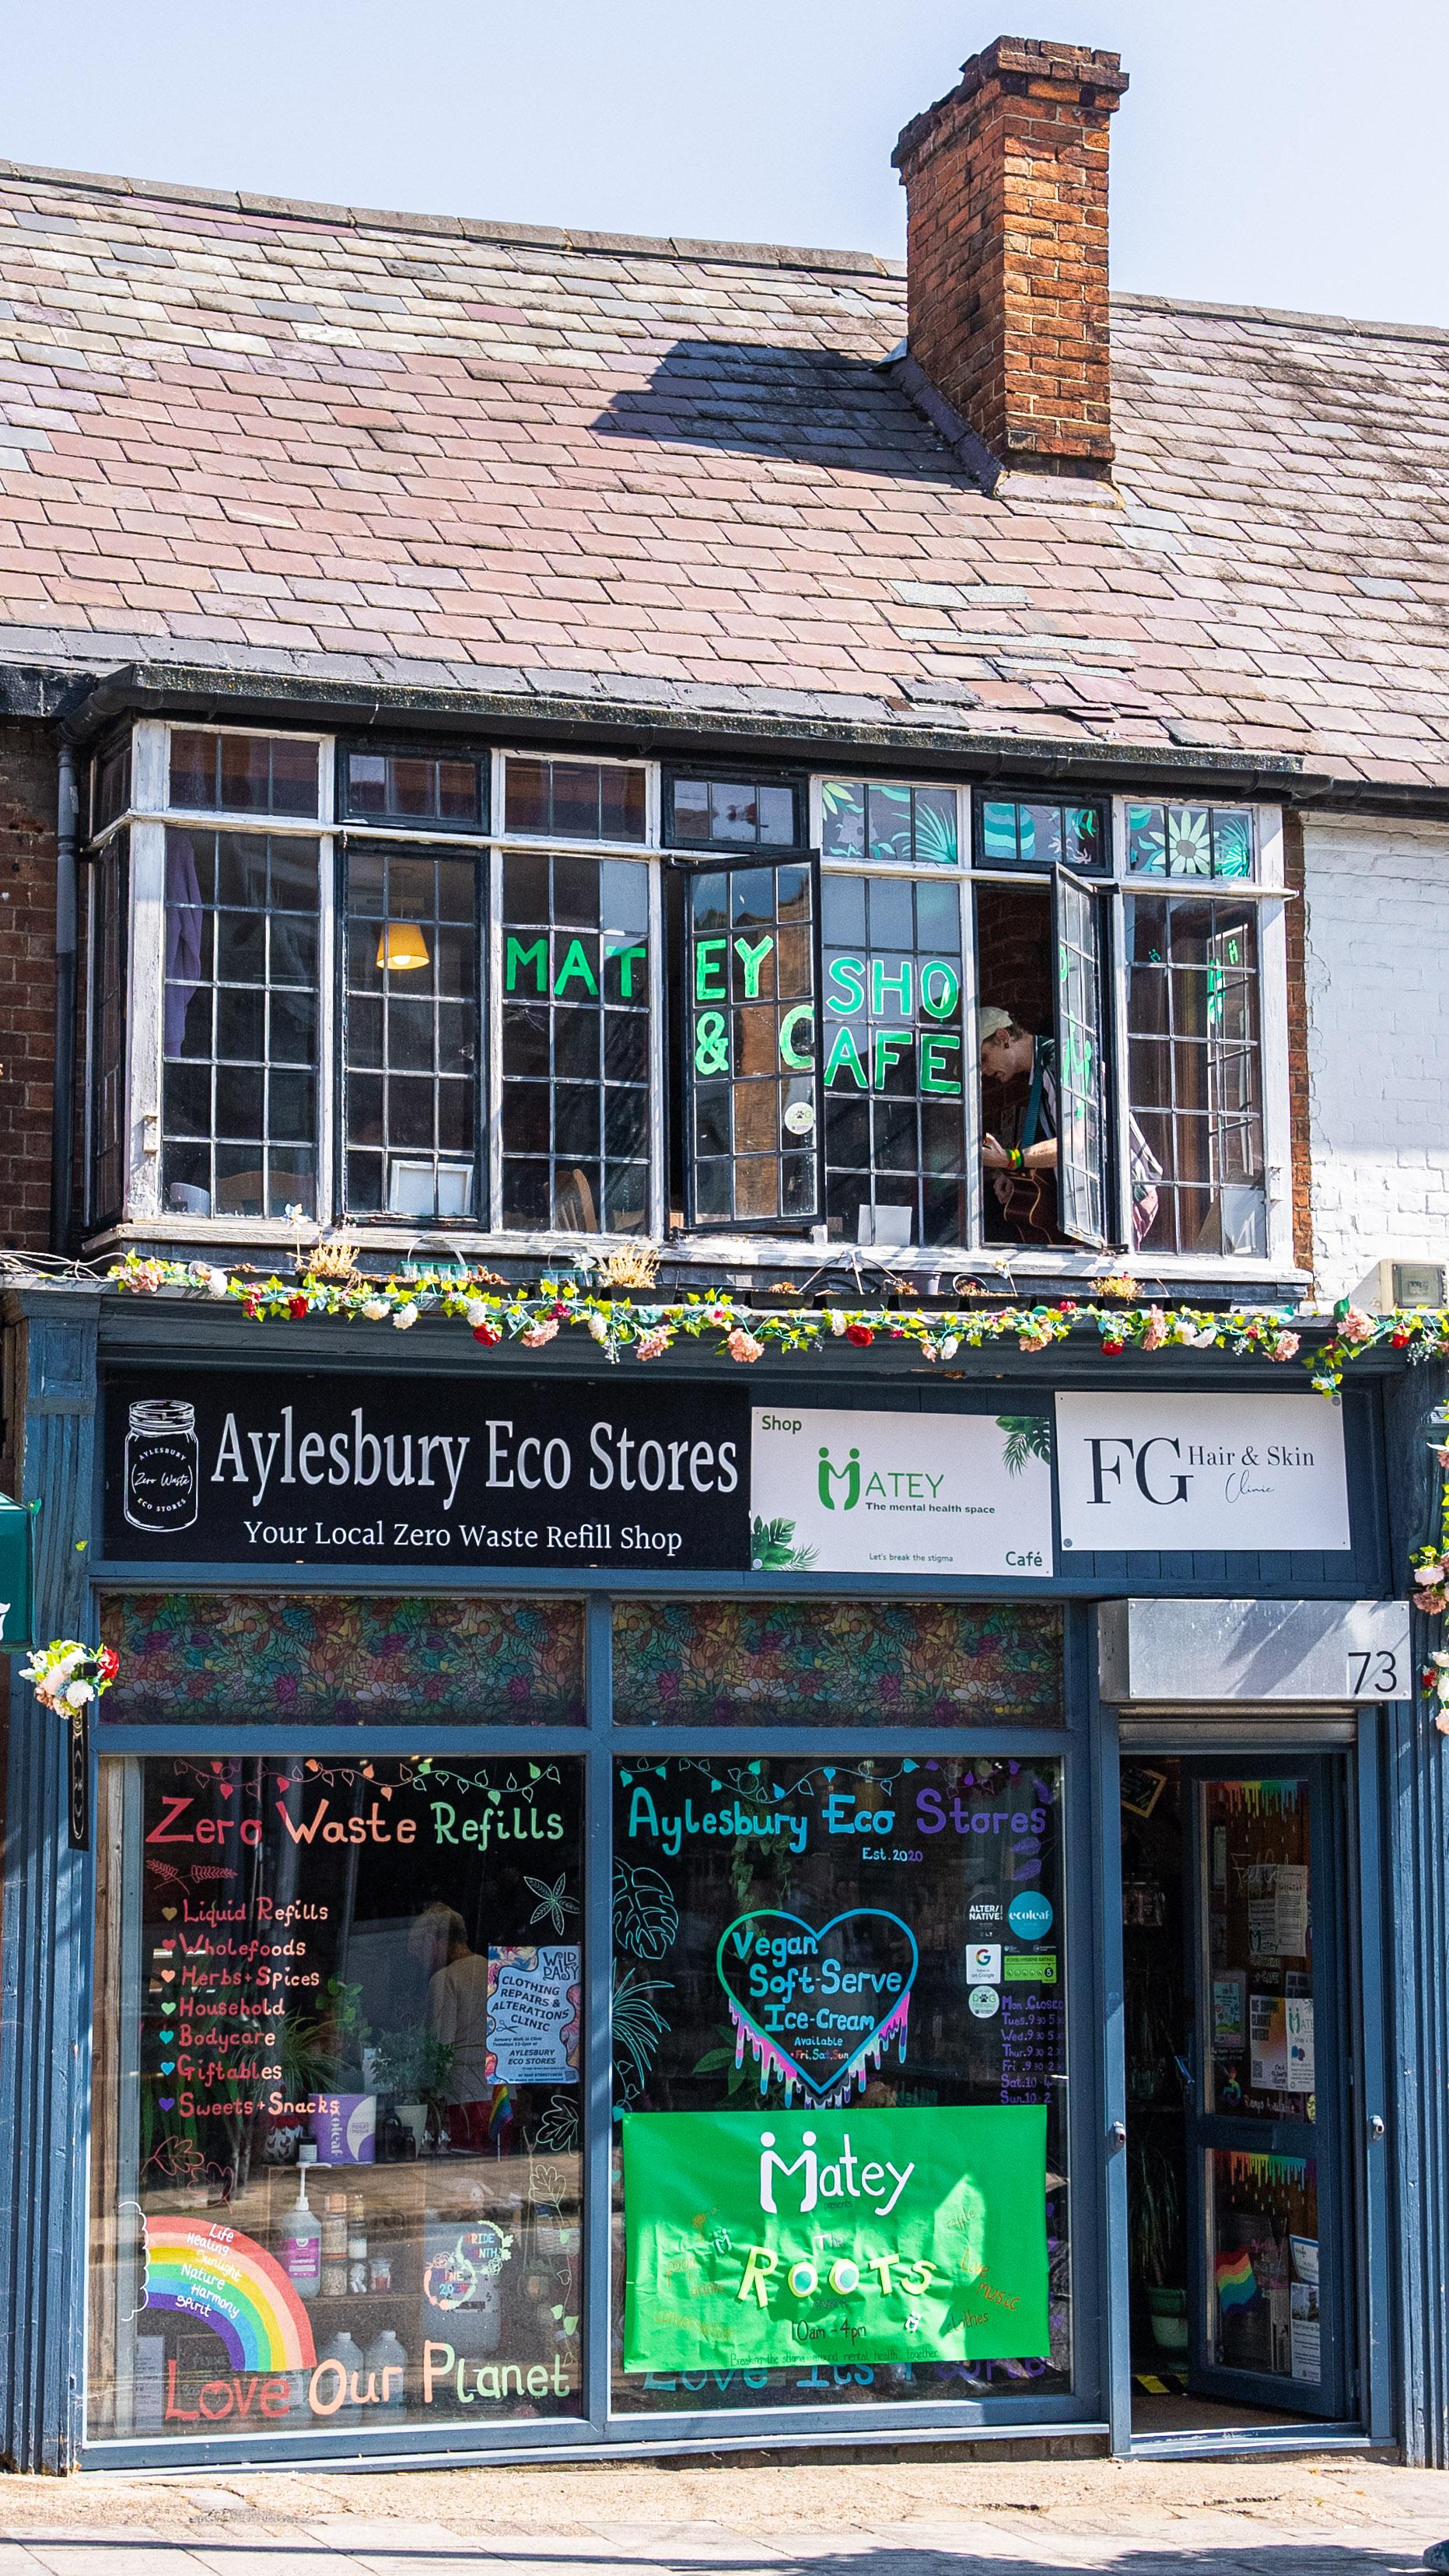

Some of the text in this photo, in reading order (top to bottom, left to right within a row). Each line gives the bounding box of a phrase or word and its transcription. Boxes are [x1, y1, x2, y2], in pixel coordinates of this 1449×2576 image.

[695, 1005, 961, 1094] & CAFE
[761, 1415, 802, 1434] Shop
[139, 1447, 186, 1461] AYLESBURY
[211, 1405, 738, 1510] Aylesbury Eco Stores
[1188, 1445, 1314, 1466] Hair & Skin
[135, 1472, 190, 1486] Zero Waste
[1083, 1437, 1194, 1505] FG
[1225, 1469, 1276, 1503] Clinic
[137, 1497, 186, 1512] ECO STORES
[866, 1502, 996, 1515] The mental health space
[243, 1520, 682, 1556] Your Local Zero Waste Refill Shop
[869, 1552, 954, 1564] Let's break the stigma
[1006, 1551, 1043, 1567] Café
[1347, 1650, 1398, 1696] 73
[145, 1796, 565, 1851] Zero Waste Refills
[628, 1787, 1047, 1856] Aylesbury Eco Stores
[183, 1896, 328, 1929] Liquid Refills
[1009, 1909, 1051, 1920] ecoleaf
[179, 1933, 306, 1962] Wholefoods
[732, 1931, 818, 1968] Vegan
[181, 1965, 242, 1986] Herbs
[255, 1965, 320, 1991] Spices
[502, 1976, 560, 1996] CLOTHING
[749, 1958, 902, 2004] Soft-Serve
[179, 1997, 285, 2017] Household
[492, 2001, 570, 2021] ALTERATIONS
[500, 1989, 561, 2008] REPAIRS &
[510, 2014, 551, 2032] CLINIC
[764, 2004, 875, 2032] Ice-Cream
[179, 2023, 276, 2053] Bodycare
[794, 2035, 843, 2046] Available
[177, 2054, 282, 2087] Giftables
[179, 2092, 254, 2117] Sweets
[268, 2091, 340, 2115] Snacks
[759, 2130, 915, 2216] Matey
[187, 2232, 229, 2257] Healing
[209, 2224, 233, 2242] Life
[813, 2233, 844, 2250] The
[181, 2263, 225, 2290] Nature
[195, 2249, 242, 2282] Sunlight
[737, 2245, 936, 2308] ROOTS
[175, 2295, 212, 2318] Spirit
[191, 2284, 240, 2319] Harmony
[977, 2282, 1020, 2311] music
[792, 2319, 825, 2341] 10am
[840, 2319, 866, 2346] 4pm
[767, 2352, 779, 2364] the
[874, 2349, 898, 2361] health
[165, 2359, 291, 2420] Love
[309, 2358, 403, 2416] Our
[422, 2339, 572, 2403] Planet
